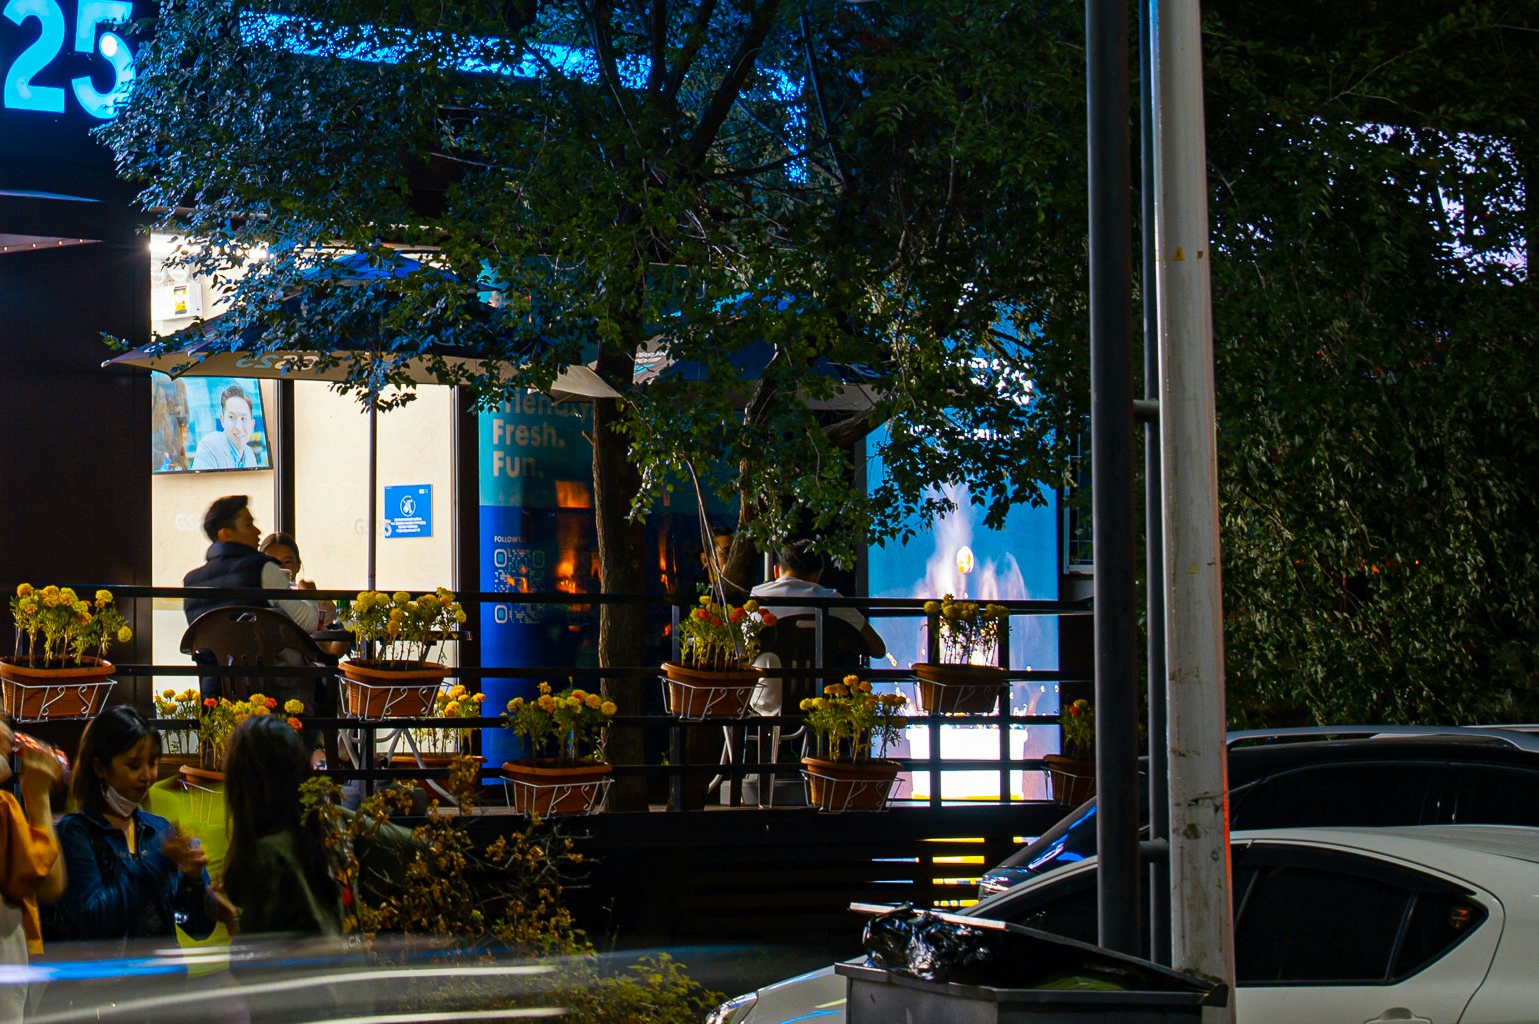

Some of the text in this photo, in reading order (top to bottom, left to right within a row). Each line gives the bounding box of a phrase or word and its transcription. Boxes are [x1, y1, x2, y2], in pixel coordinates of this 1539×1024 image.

[493, 418, 565, 448] Fresh.
[493, 451, 544, 478] Fun.
[494, 535, 518, 543] FOLLOW
